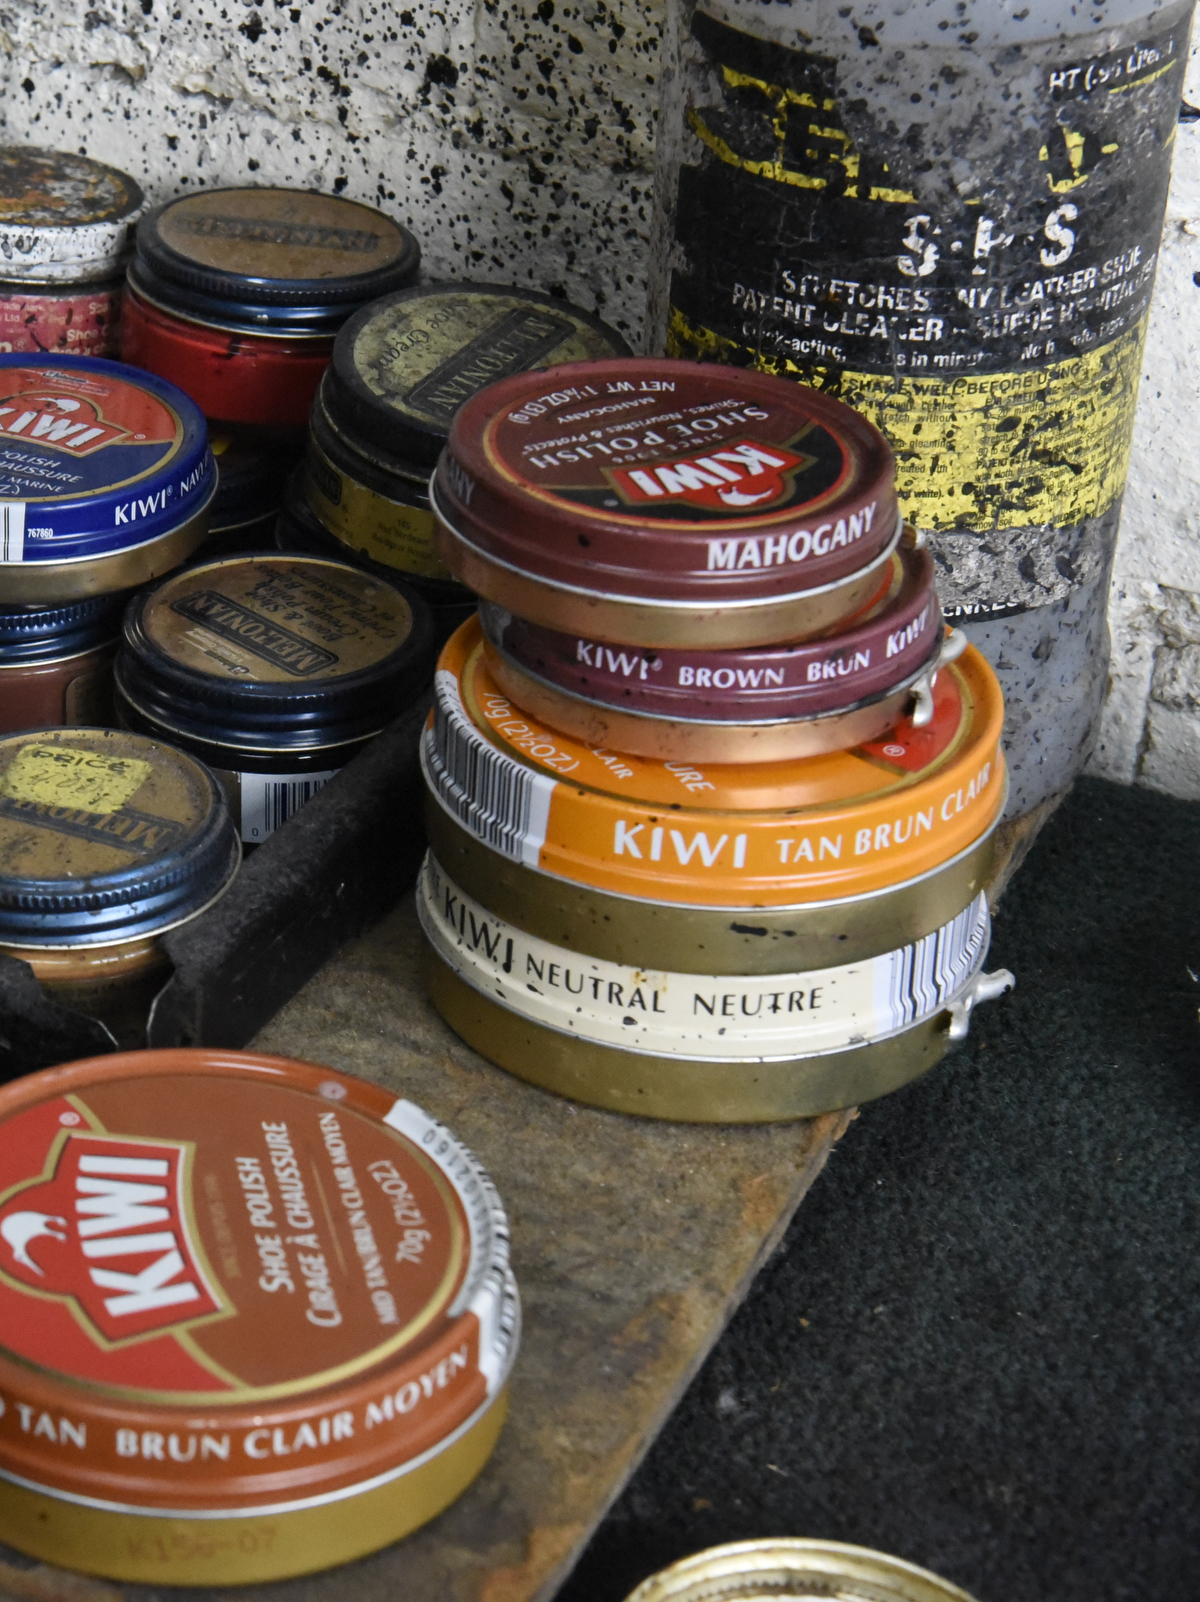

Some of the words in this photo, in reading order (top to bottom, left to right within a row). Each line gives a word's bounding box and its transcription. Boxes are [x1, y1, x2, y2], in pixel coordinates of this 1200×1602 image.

[606, 381, 637, 394] WT
[638, 380, 676, 392] NET
[966, 377, 1033, 396] BEFORE
[557, 396, 657, 425] MAHOGANY
[604, 412, 684, 433] Nourishes
[667, 406, 770, 438] SHOE
[528, 431, 667, 469] POLISH
[589, 429, 604, 440] &
[6, 476, 65, 494] MARINE
[627, 443, 787, 497] KIWI
[114, 490, 168, 527] KIWI
[26, 526, 54, 539] 767860
[705, 500, 879, 571] MAHOGANY
[191, 595, 320, 673] MELTONIAN
[576, 639, 649, 681] KIWI
[678, 665, 786, 689] BROWN
[806, 648, 871, 683] BRUN
[31, 749, 131, 775] PRICE
[250, 827, 260, 837] 0
[612, 819, 749, 869] KIWI
[776, 834, 844, 865] TAN
[853, 810, 935, 856] BRUN
[939, 759, 993, 822] CLAIR
[443, 886, 514, 974] KIWI
[525, 952, 668, 1015] NEUTRAL
[692, 986, 825, 1017] NEUTRE
[317, 1111, 349, 1166] MOYEN
[234, 1156, 278, 1229] POLISH
[260, 1120, 315, 1231] CHAUSSURE
[332, 1165, 365, 1210] CLAIR
[75, 1153, 201, 1318] KIWI
[395, 1228, 433, 1266] 70g
[254, 1232, 296, 1294] SHOE
[296, 1251, 344, 1329] CIRAGE
[369, 1288, 400, 1326] MID
[14, 1404, 88, 1452] TAN
[114, 1427, 232, 1463] BRUN
[242, 1411, 356, 1460] CLAIR
[363, 1343, 470, 1431] MOYEN
